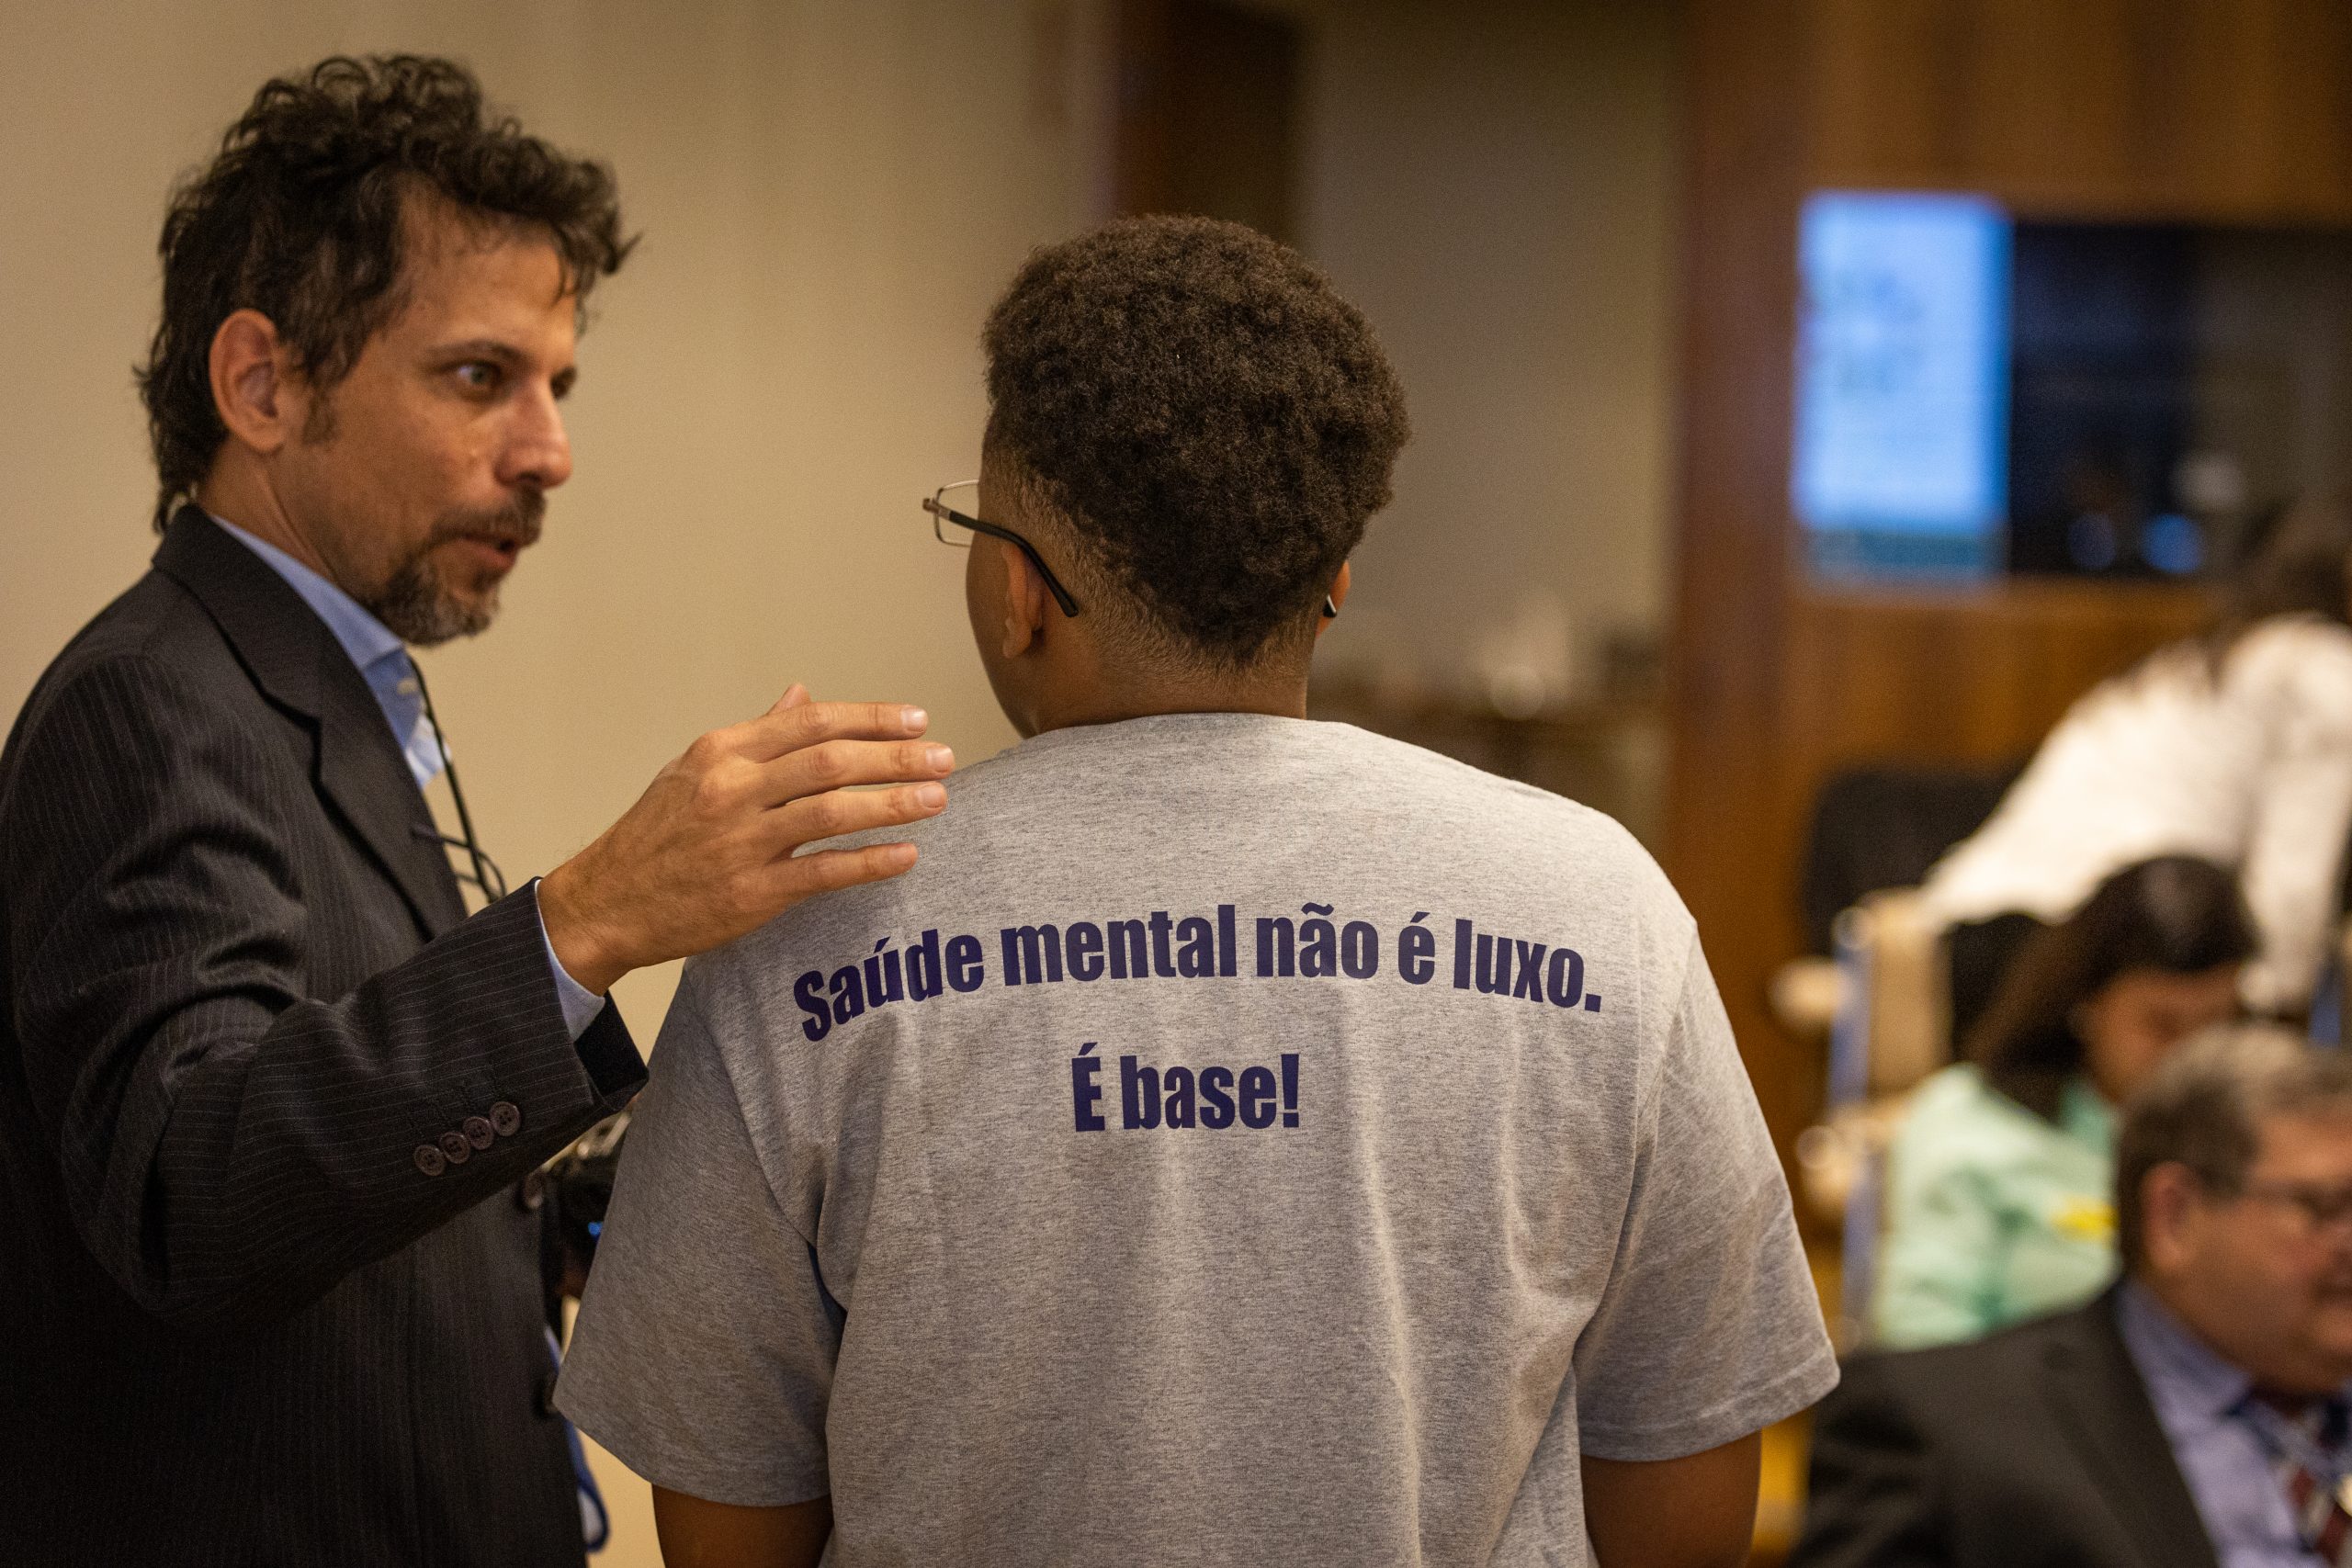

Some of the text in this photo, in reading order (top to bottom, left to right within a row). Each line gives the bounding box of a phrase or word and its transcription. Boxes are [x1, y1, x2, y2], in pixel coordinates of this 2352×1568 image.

[796, 904, 1600, 1041] Saúde mental não é luxo.
[1071, 1043, 1299, 1132] É base!
